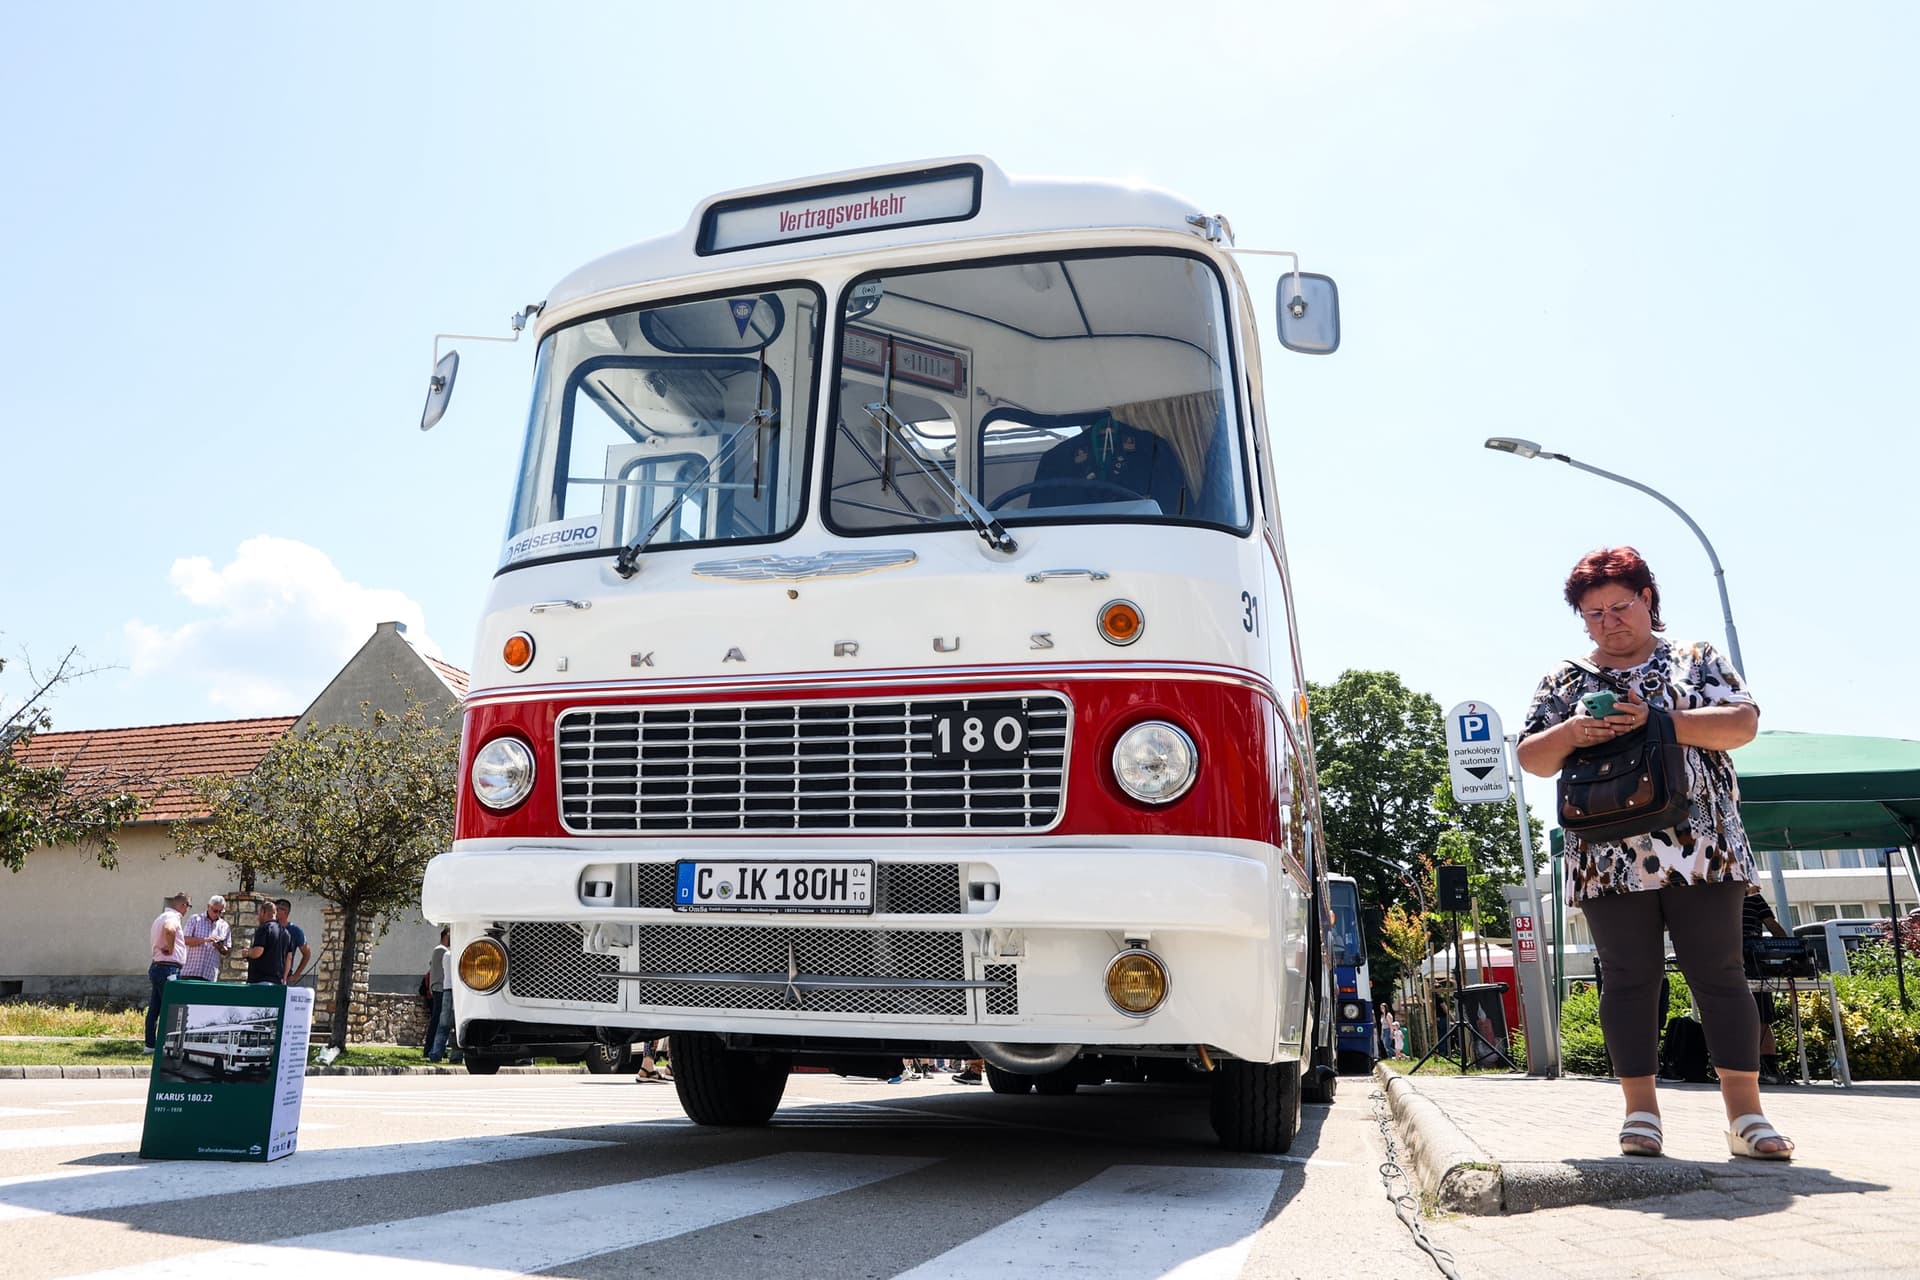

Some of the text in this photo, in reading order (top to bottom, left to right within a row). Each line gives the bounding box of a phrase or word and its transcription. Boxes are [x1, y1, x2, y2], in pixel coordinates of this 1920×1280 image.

[780, 193, 906, 232] Vertragsverkehr
[514, 526, 598, 555] REISEBÜRO
[1241, 590, 1260, 638] 31
[556, 632, 1054, 672] IKARUS
[1467, 703, 1477, 715] 2
[937, 716, 1023, 752] 180
[1463, 716, 1484, 741] P
[1454, 746, 1501, 757] parkolójegy
[1460, 757, 1498, 766] automata
[1461, 783, 1503, 794] jegyváltás
[852, 868, 866, 877] 04
[697, 868, 848, 900] C IK 180H
[681, 887, 689, 898] D
[852, 891, 866, 900] 10
[155, 1092, 213, 1102] IKARUS 180.22
